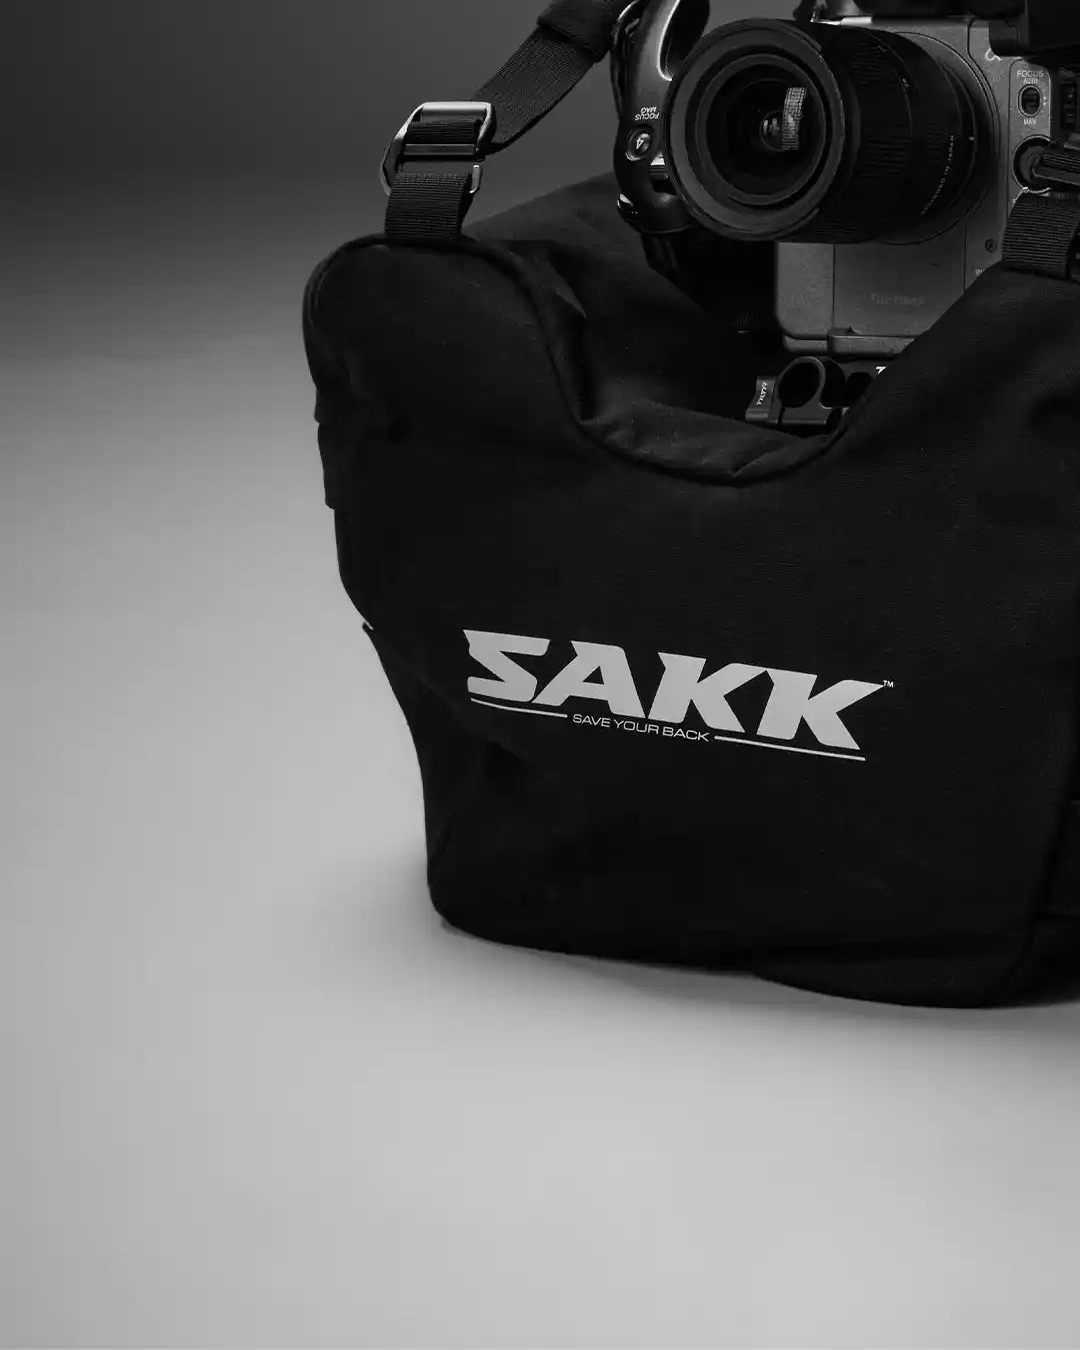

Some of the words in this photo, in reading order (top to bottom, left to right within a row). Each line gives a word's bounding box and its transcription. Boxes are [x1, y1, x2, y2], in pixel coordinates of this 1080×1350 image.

[1016, 69, 1044, 78] FOCUS
[634, 112, 660, 121] FOCUS
[635, 137, 645, 150] 4
[462, 629, 885, 751] SAKK
[572, 713, 611, 728] SAVE
[613, 719, 660, 735] YOUR
[662, 727, 711, 742] BACK
